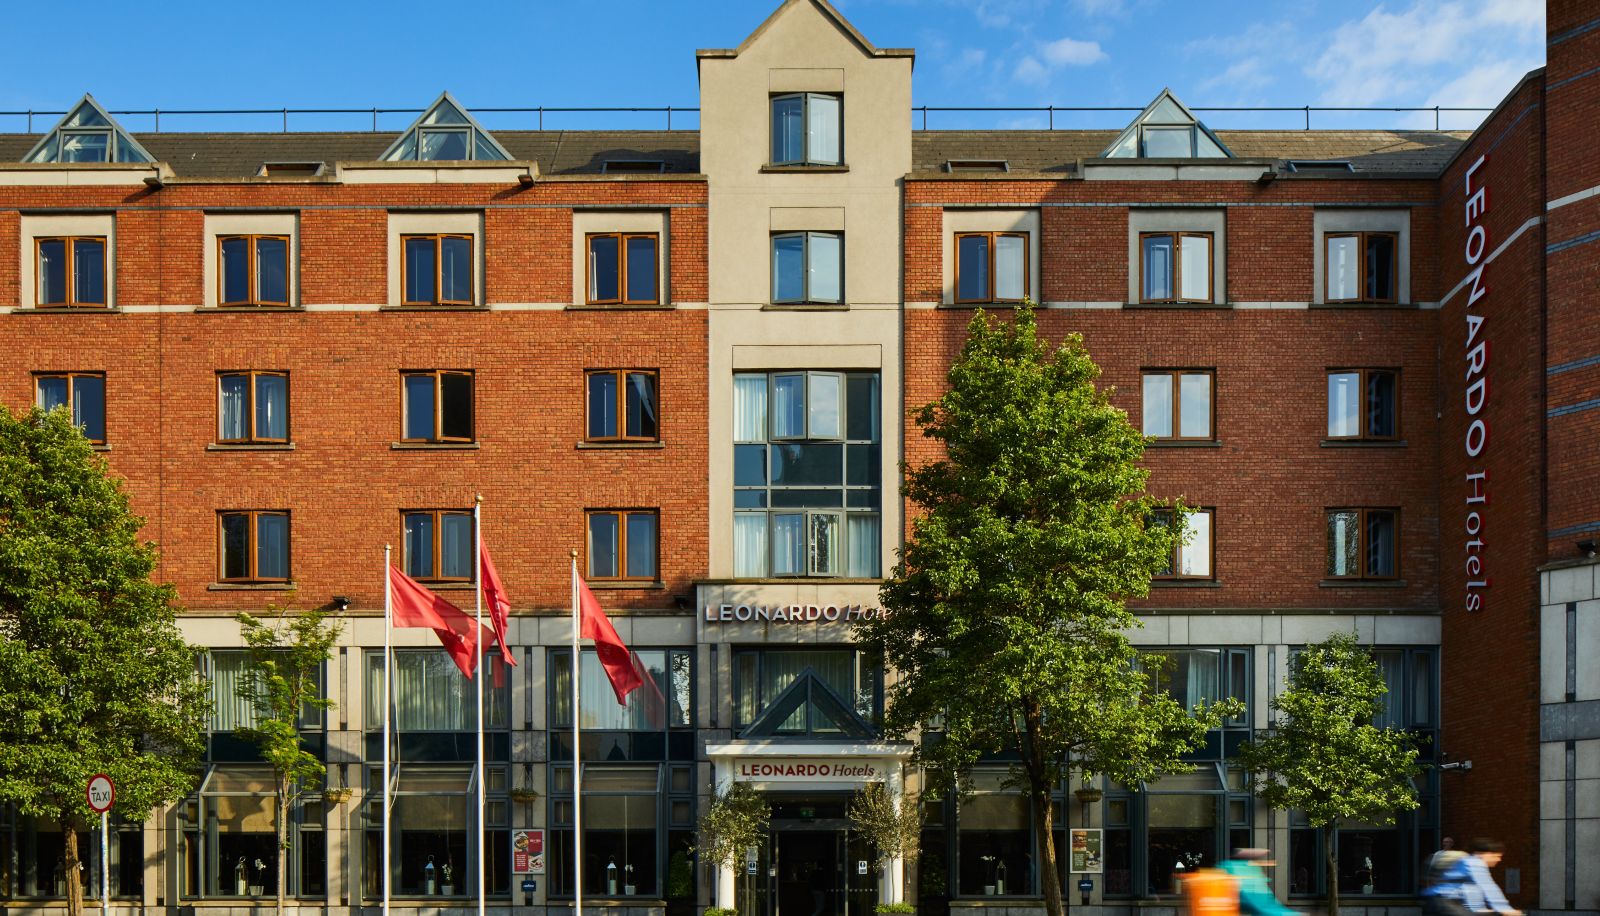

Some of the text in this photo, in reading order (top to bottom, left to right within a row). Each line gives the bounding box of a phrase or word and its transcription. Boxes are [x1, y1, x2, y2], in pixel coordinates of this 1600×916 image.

[1465, 154, 1487, 612] LEONARDO Hotels
[705, 604, 841, 621] LEONARDO
[741, 763, 875, 777] LEONARDO Hotels
[91, 791, 110, 802] TAXI
